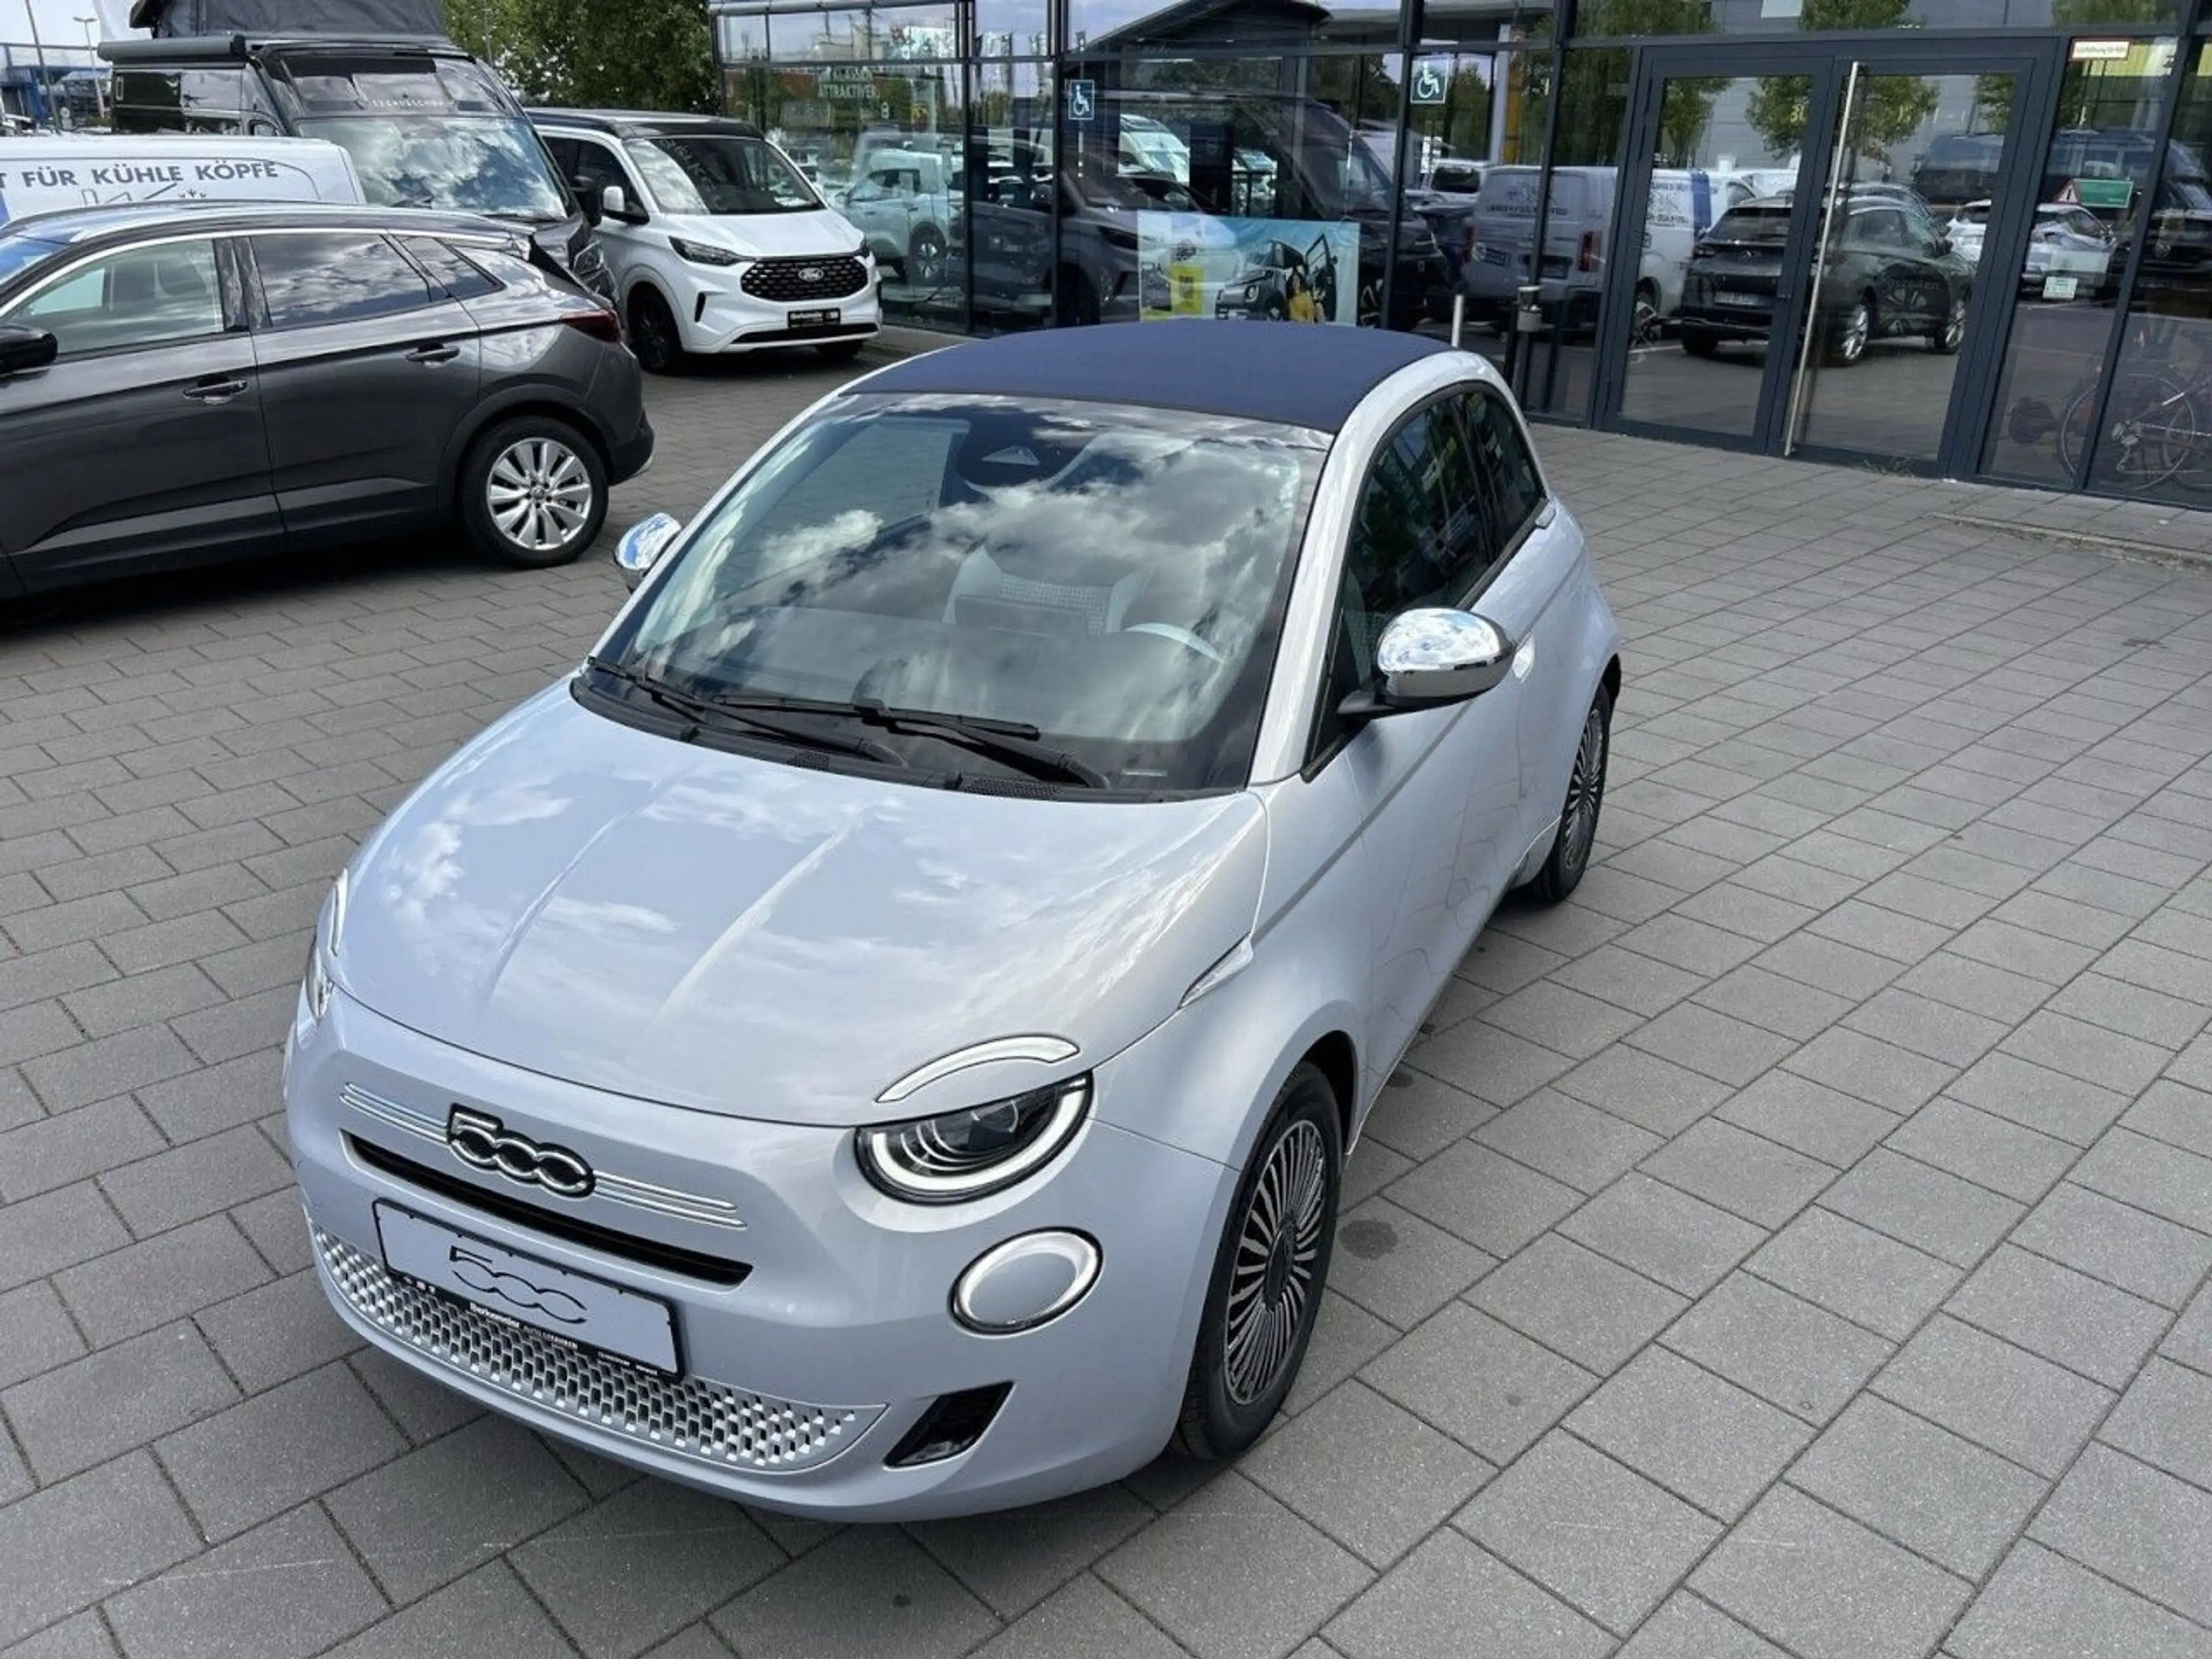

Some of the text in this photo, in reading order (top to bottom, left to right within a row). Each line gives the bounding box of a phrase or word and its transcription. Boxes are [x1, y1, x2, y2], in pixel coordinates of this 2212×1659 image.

[21, 166, 79, 187] FÜR
[91, 164, 184, 184] KÜHLE
[194, 160, 279, 180] KÖPFE
[449, 1106, 593, 1196] 500
[449, 1245, 587, 1324] 500
